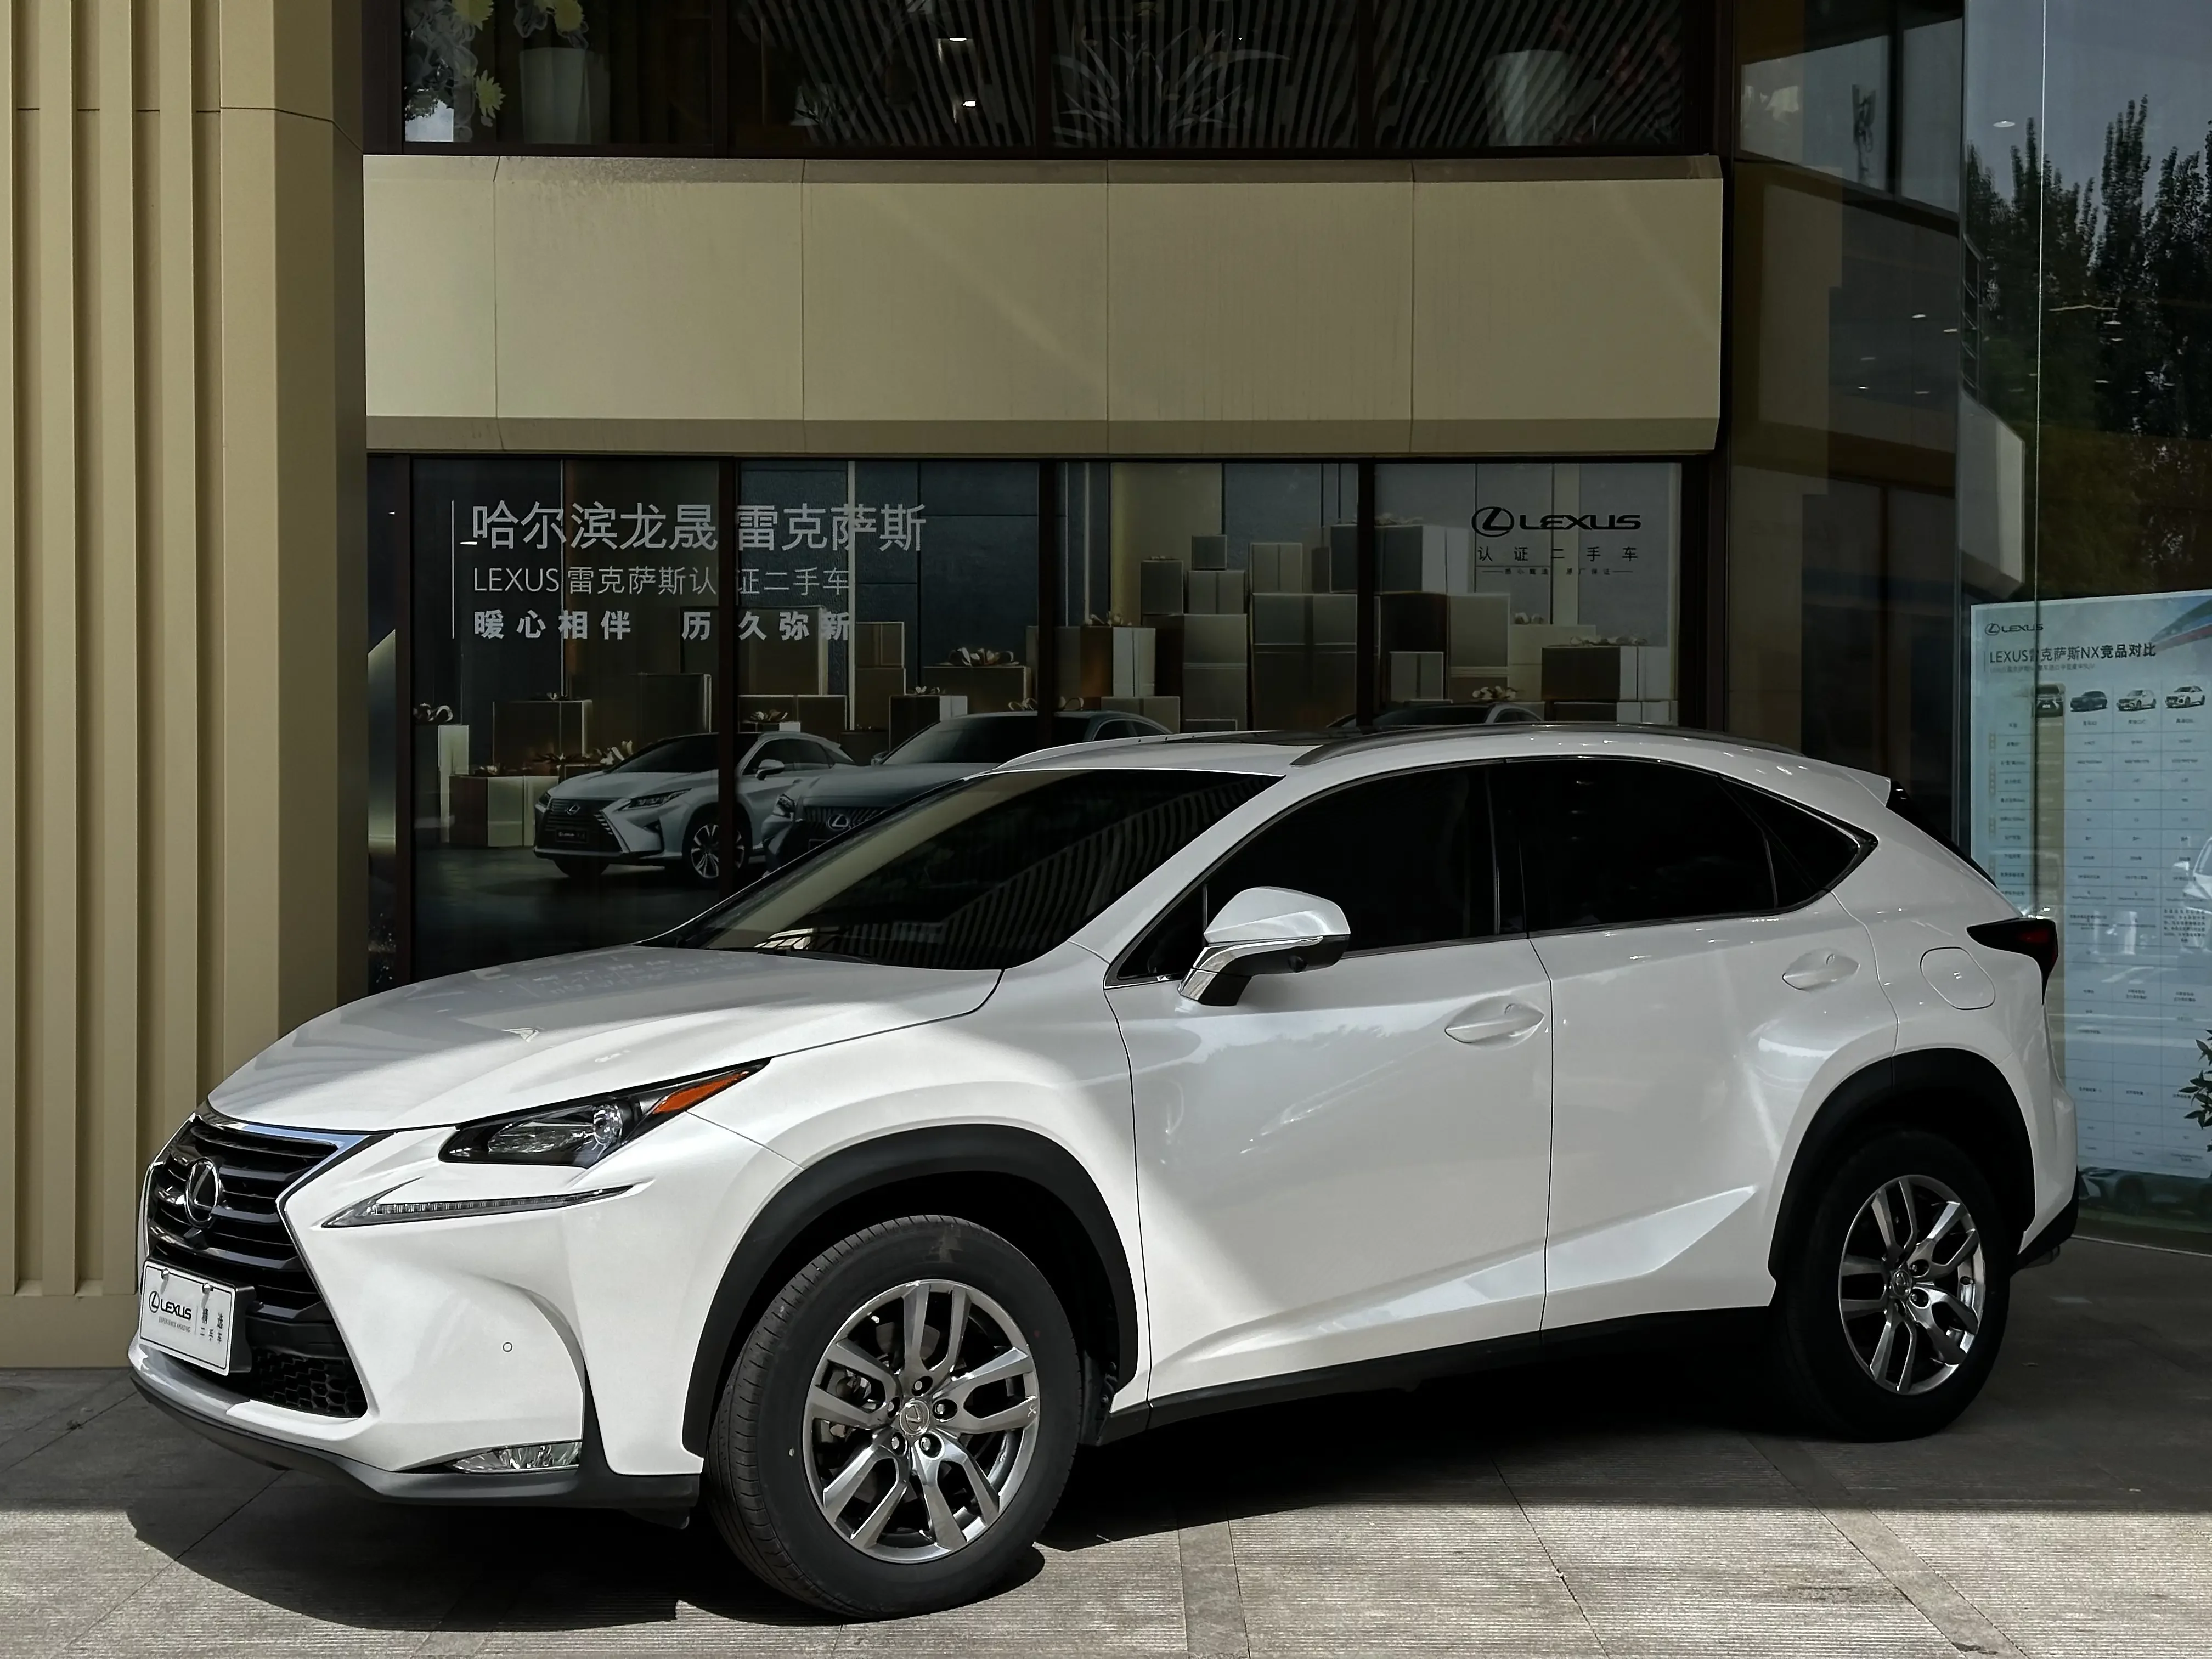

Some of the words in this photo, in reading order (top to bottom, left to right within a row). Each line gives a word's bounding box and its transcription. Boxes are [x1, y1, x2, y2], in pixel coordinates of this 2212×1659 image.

[472, 499, 718, 550] 哈尔滨龙晟
[736, 504, 927, 552] 雷克萨斯
[1519, 515, 1641, 530] LEXUS
[1477, 546, 1638, 562] 认证二手车
[474, 610, 631, 640] 暖心相伴
[681, 611, 850, 641] 历久弥新
[2001, 623, 2044, 633] LEXUS
[161, 1299, 192, 1321] LEXUS
